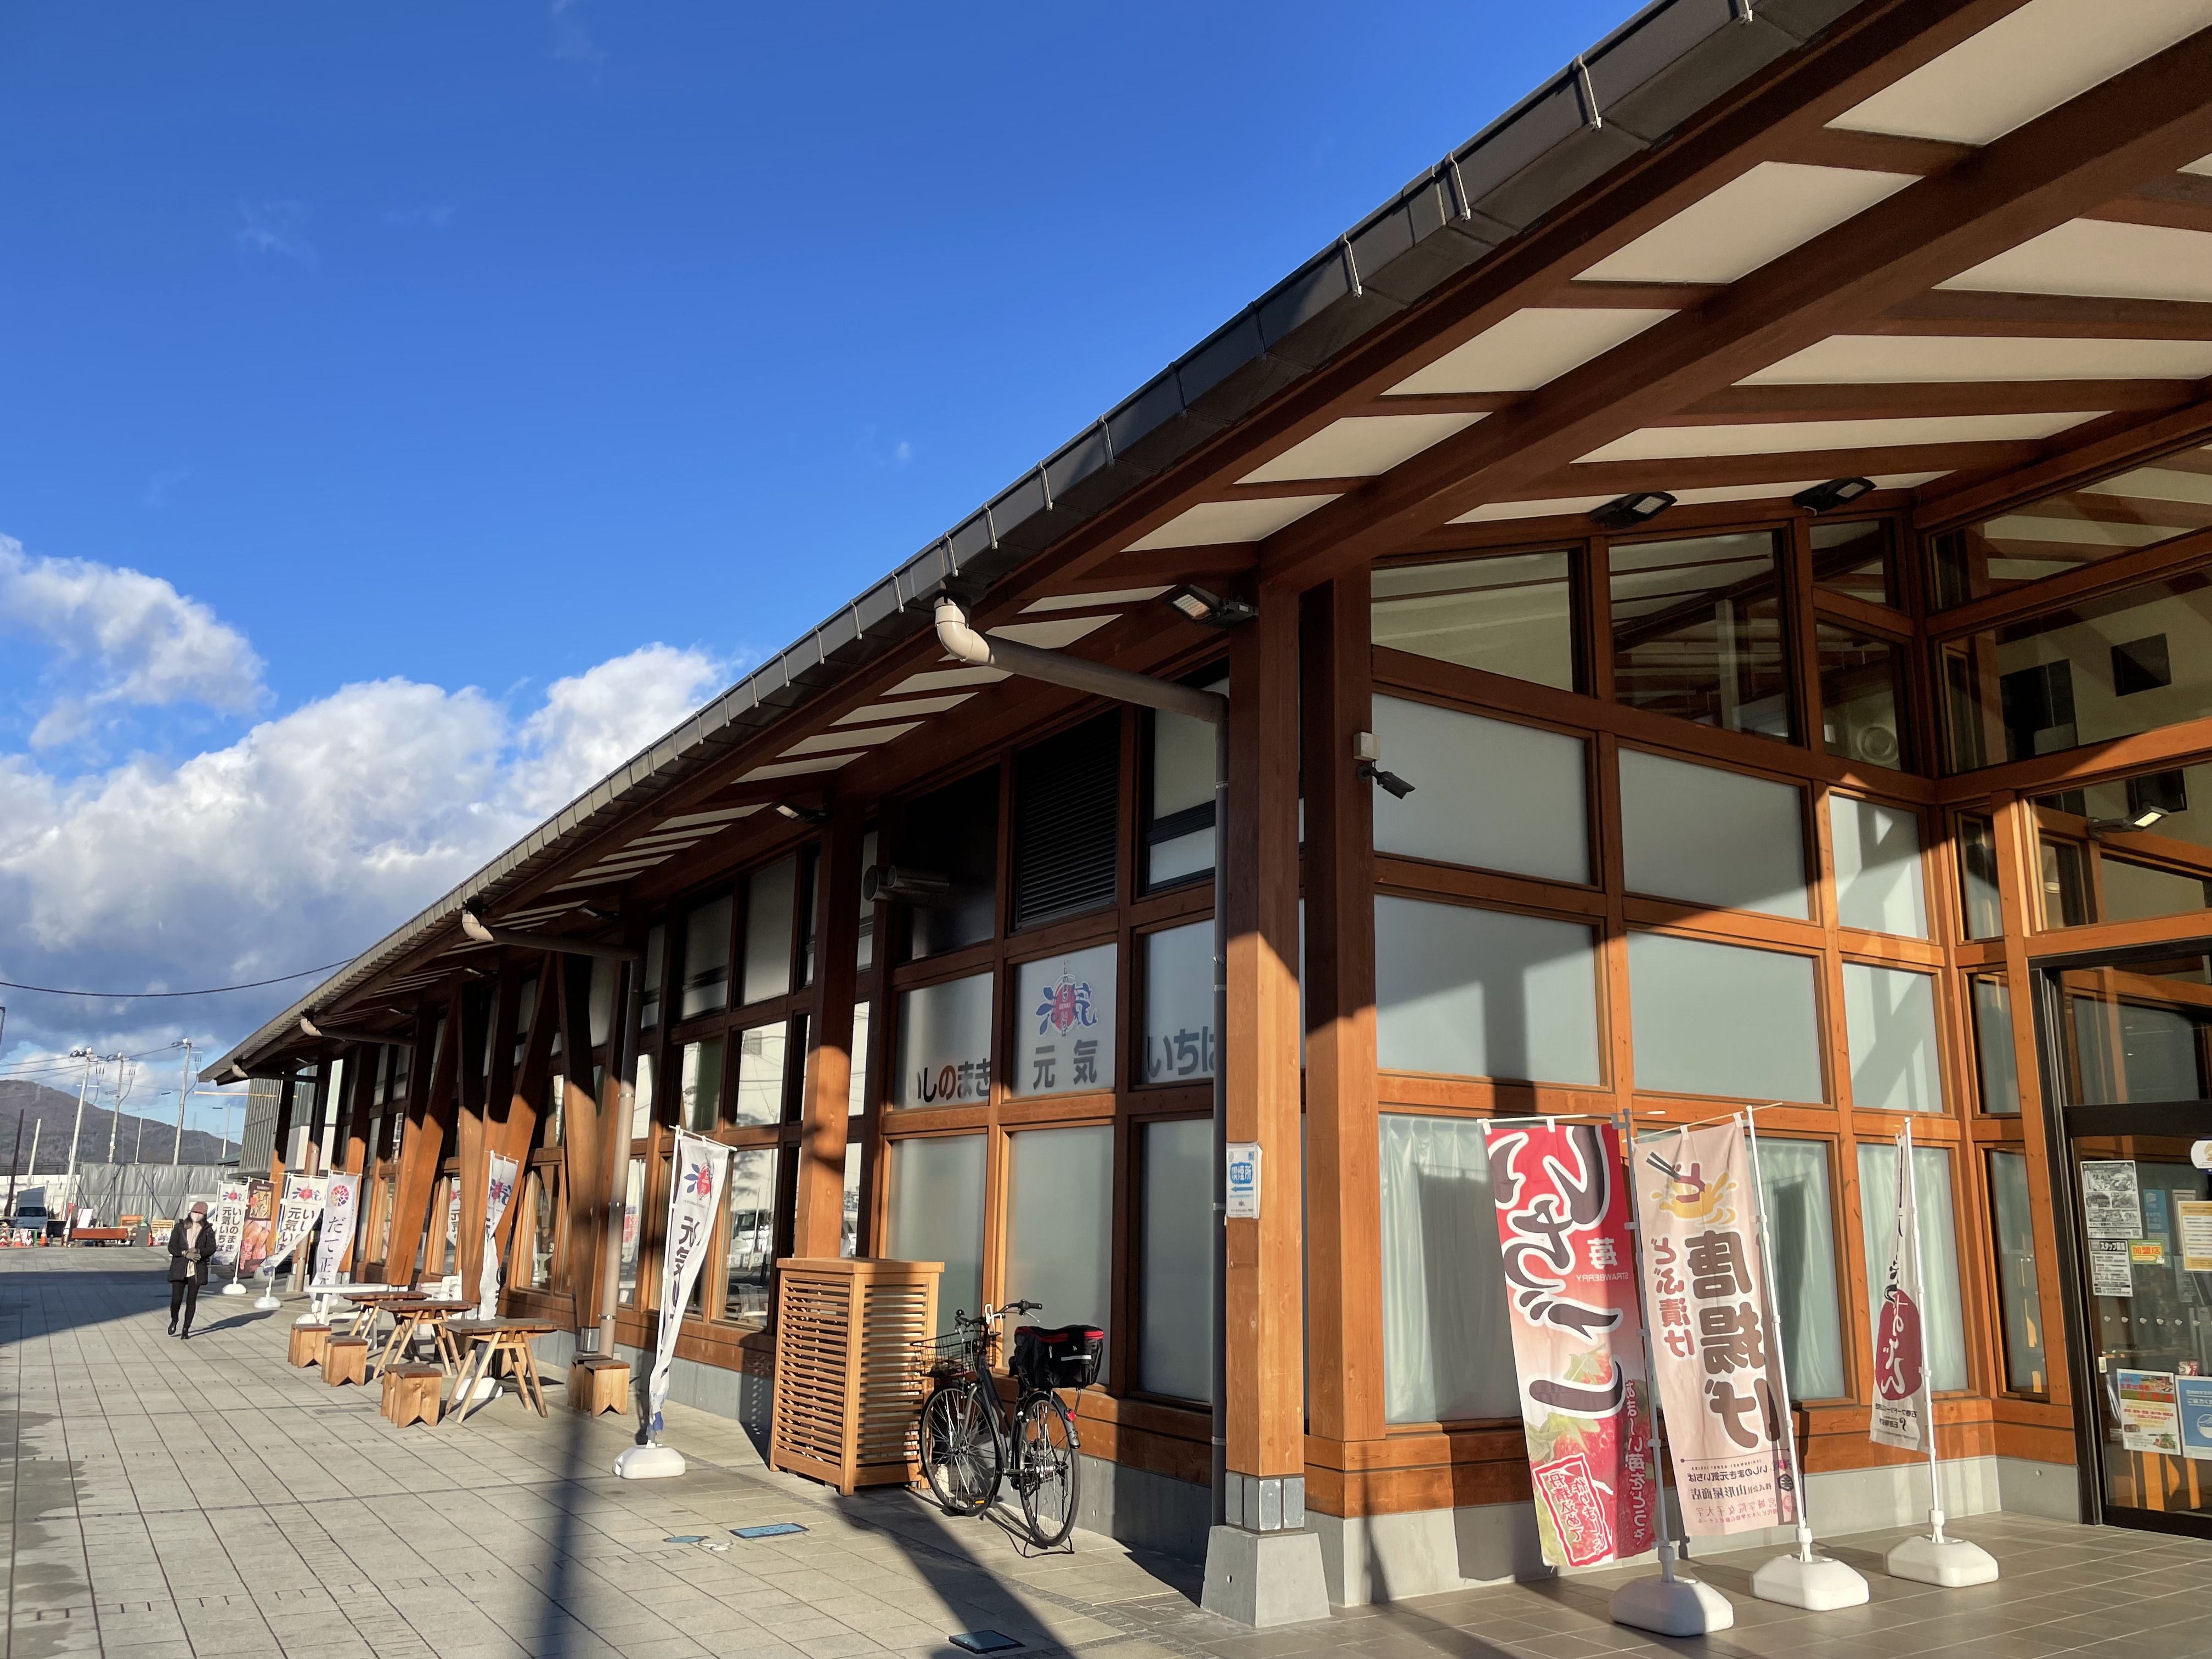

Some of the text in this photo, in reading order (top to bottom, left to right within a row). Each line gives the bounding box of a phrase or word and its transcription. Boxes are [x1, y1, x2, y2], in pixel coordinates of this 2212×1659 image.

[1033, 1040, 1098, 1090] 元気
[216, 1206, 232, 1252] 元気いちば
[225, 1207, 242, 1252] いしのまき
[2132, 1246, 2161, 1255] 加盟店
